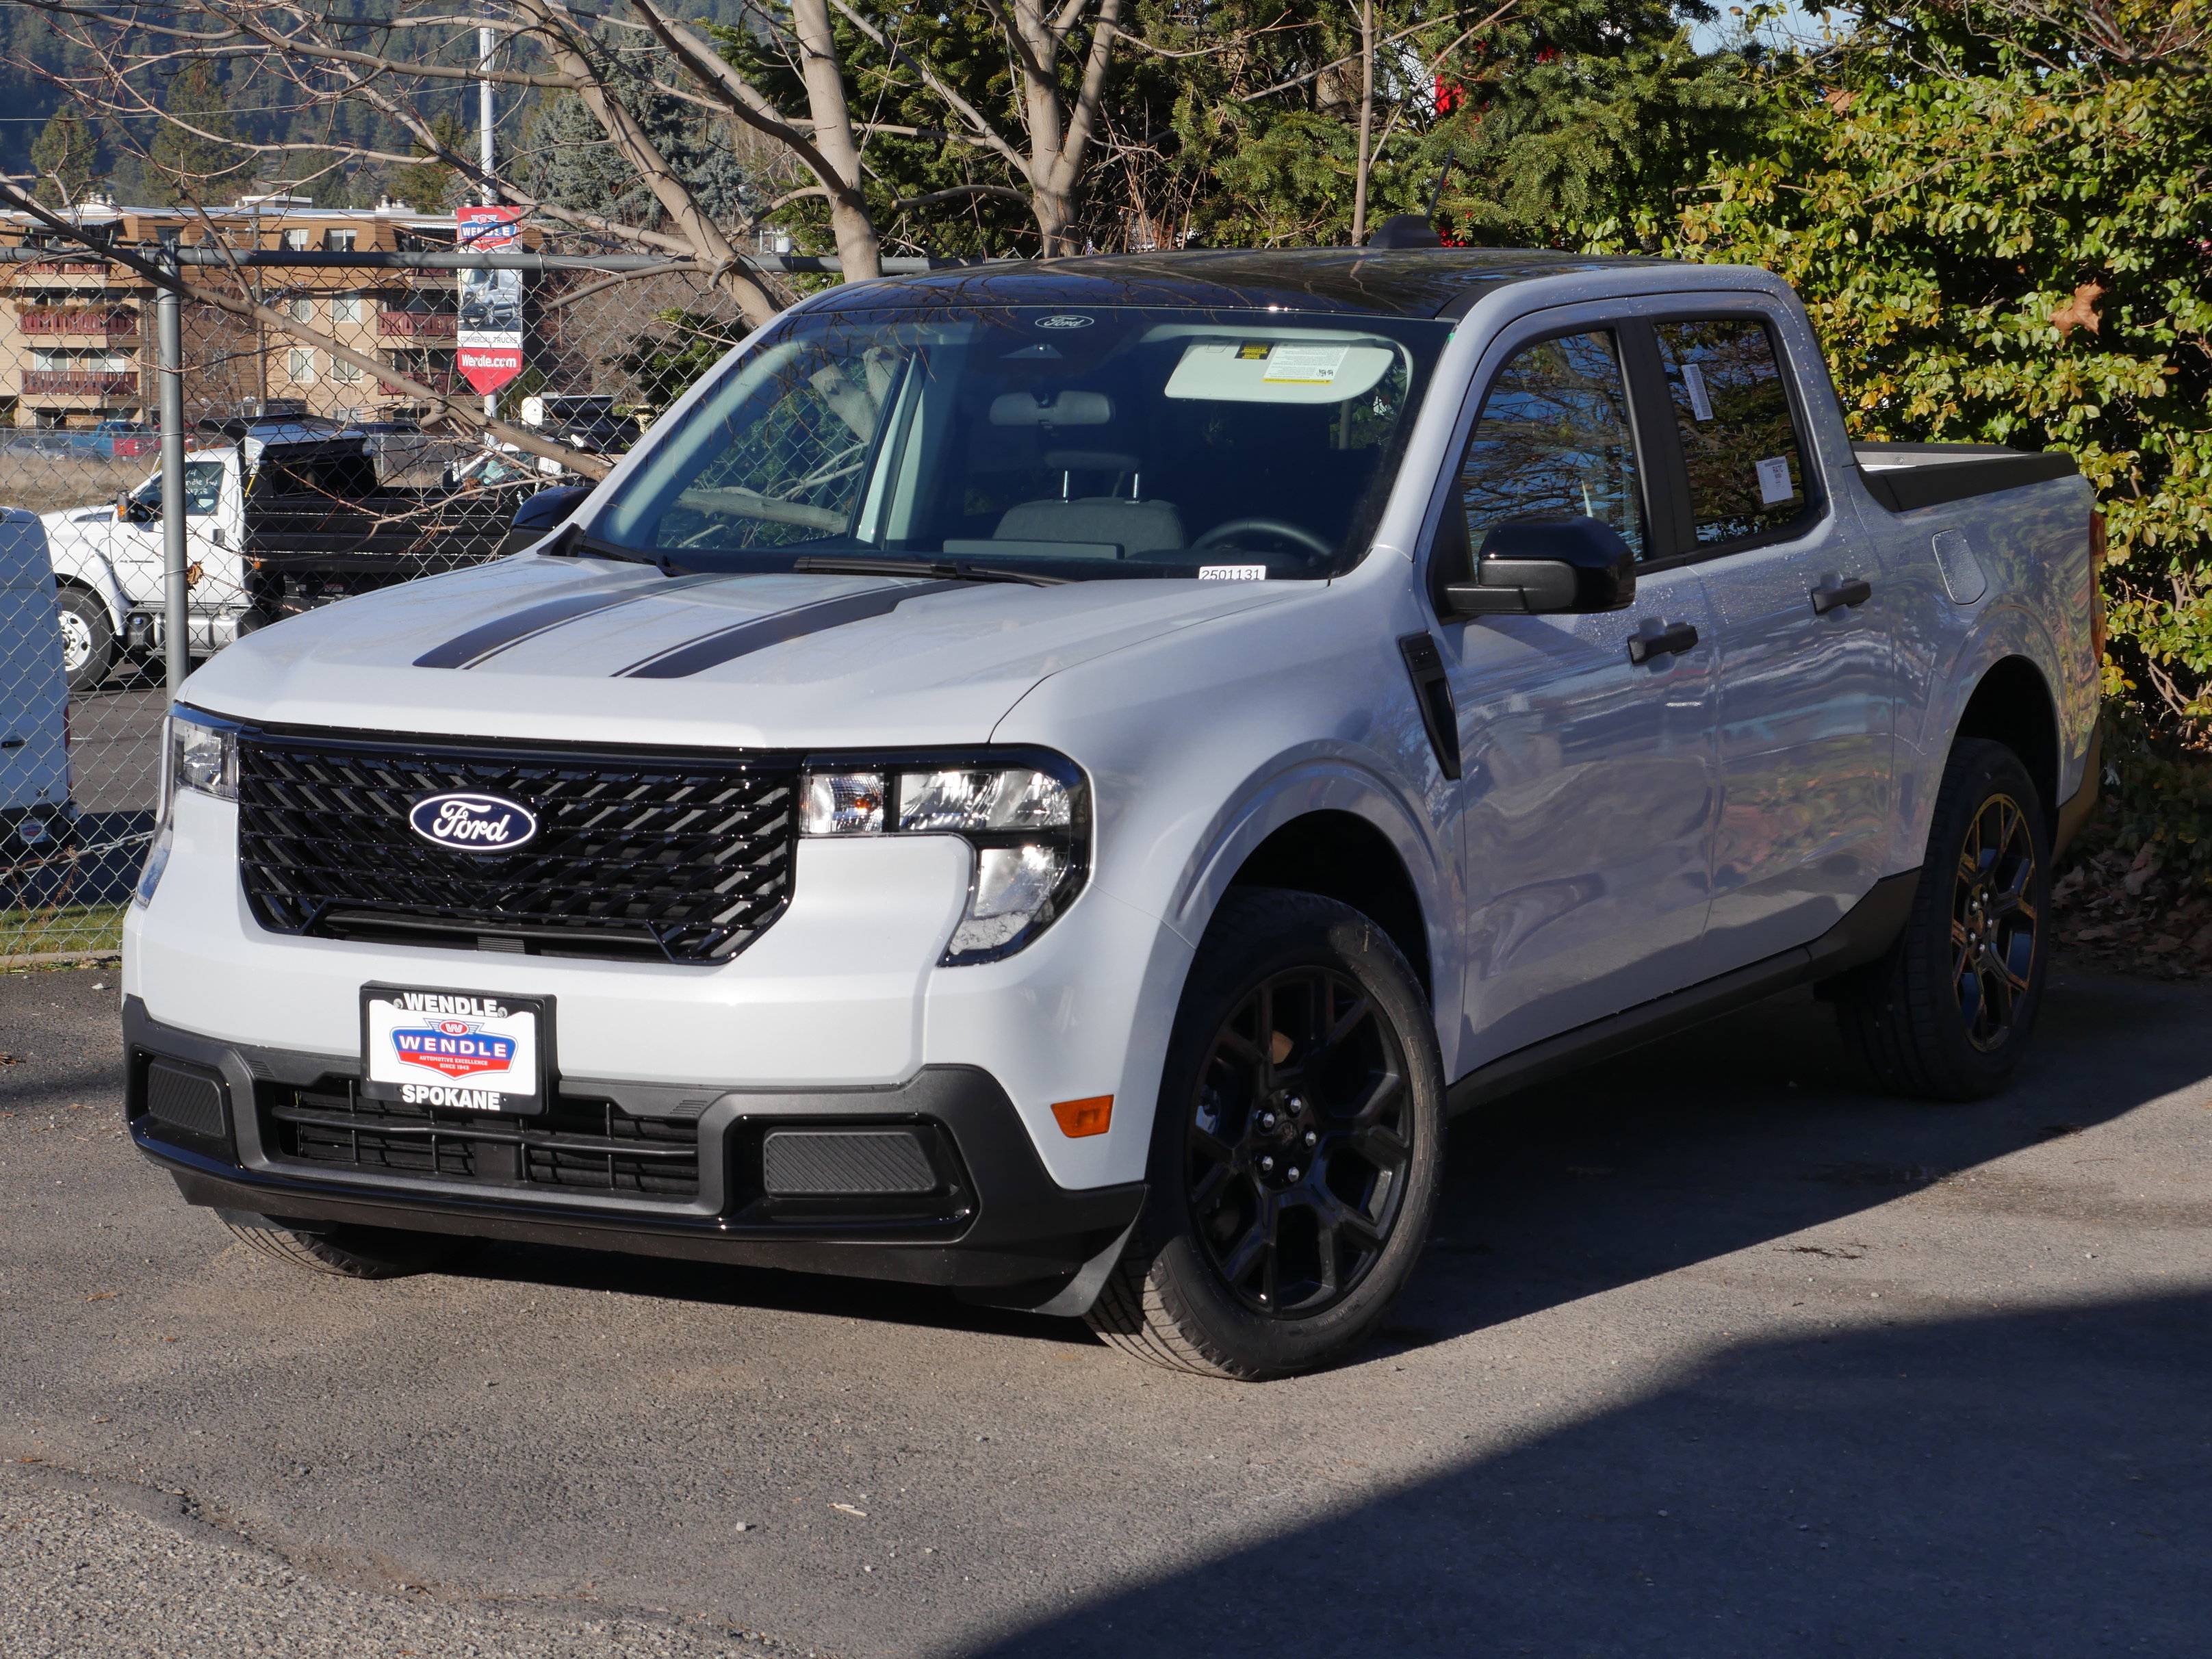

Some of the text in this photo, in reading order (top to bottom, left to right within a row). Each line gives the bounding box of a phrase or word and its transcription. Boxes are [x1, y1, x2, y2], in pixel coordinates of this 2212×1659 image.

[1044, 317, 1085, 326] Ford
[1202, 569, 1259, 580] 2501131
[433, 800, 511, 842] Ford
[402, 992, 498, 1018] WENDLE
[445, 1023, 463, 1033] W
[399, 1035, 506, 1057] WENDLE
[419, 1055, 488, 1066] AUTOMOTIVE EXCELLENCE
[402, 1084, 500, 1111] SPOKANE
